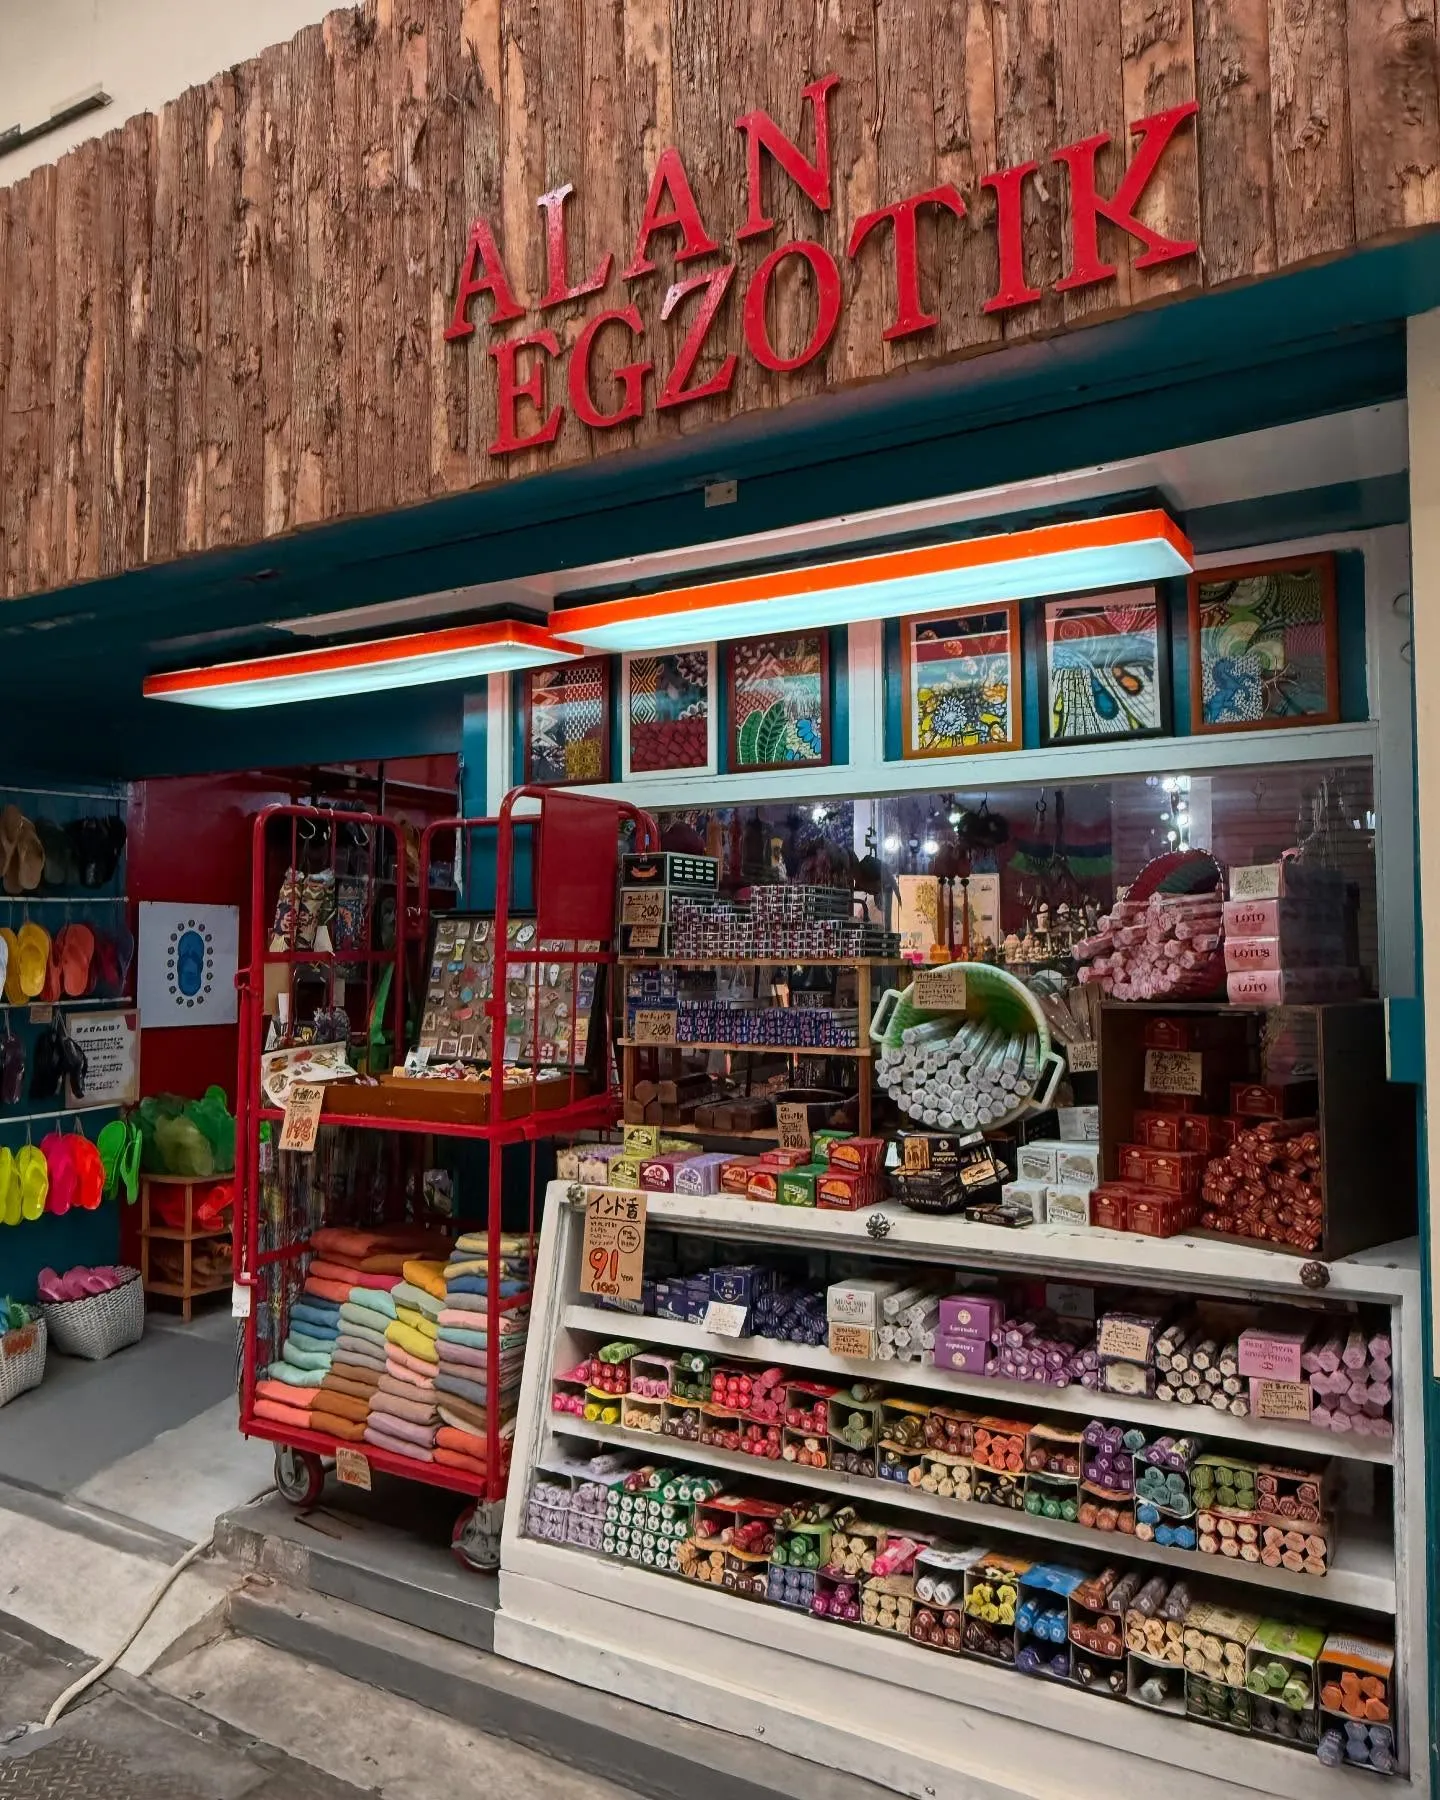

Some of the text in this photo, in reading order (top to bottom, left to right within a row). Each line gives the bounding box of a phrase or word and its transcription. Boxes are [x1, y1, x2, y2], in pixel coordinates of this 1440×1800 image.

[443, 73, 841, 342] ALAN
[488, 100, 1200, 456] EGZOTIK
[589, 1247, 618, 1281] 91
